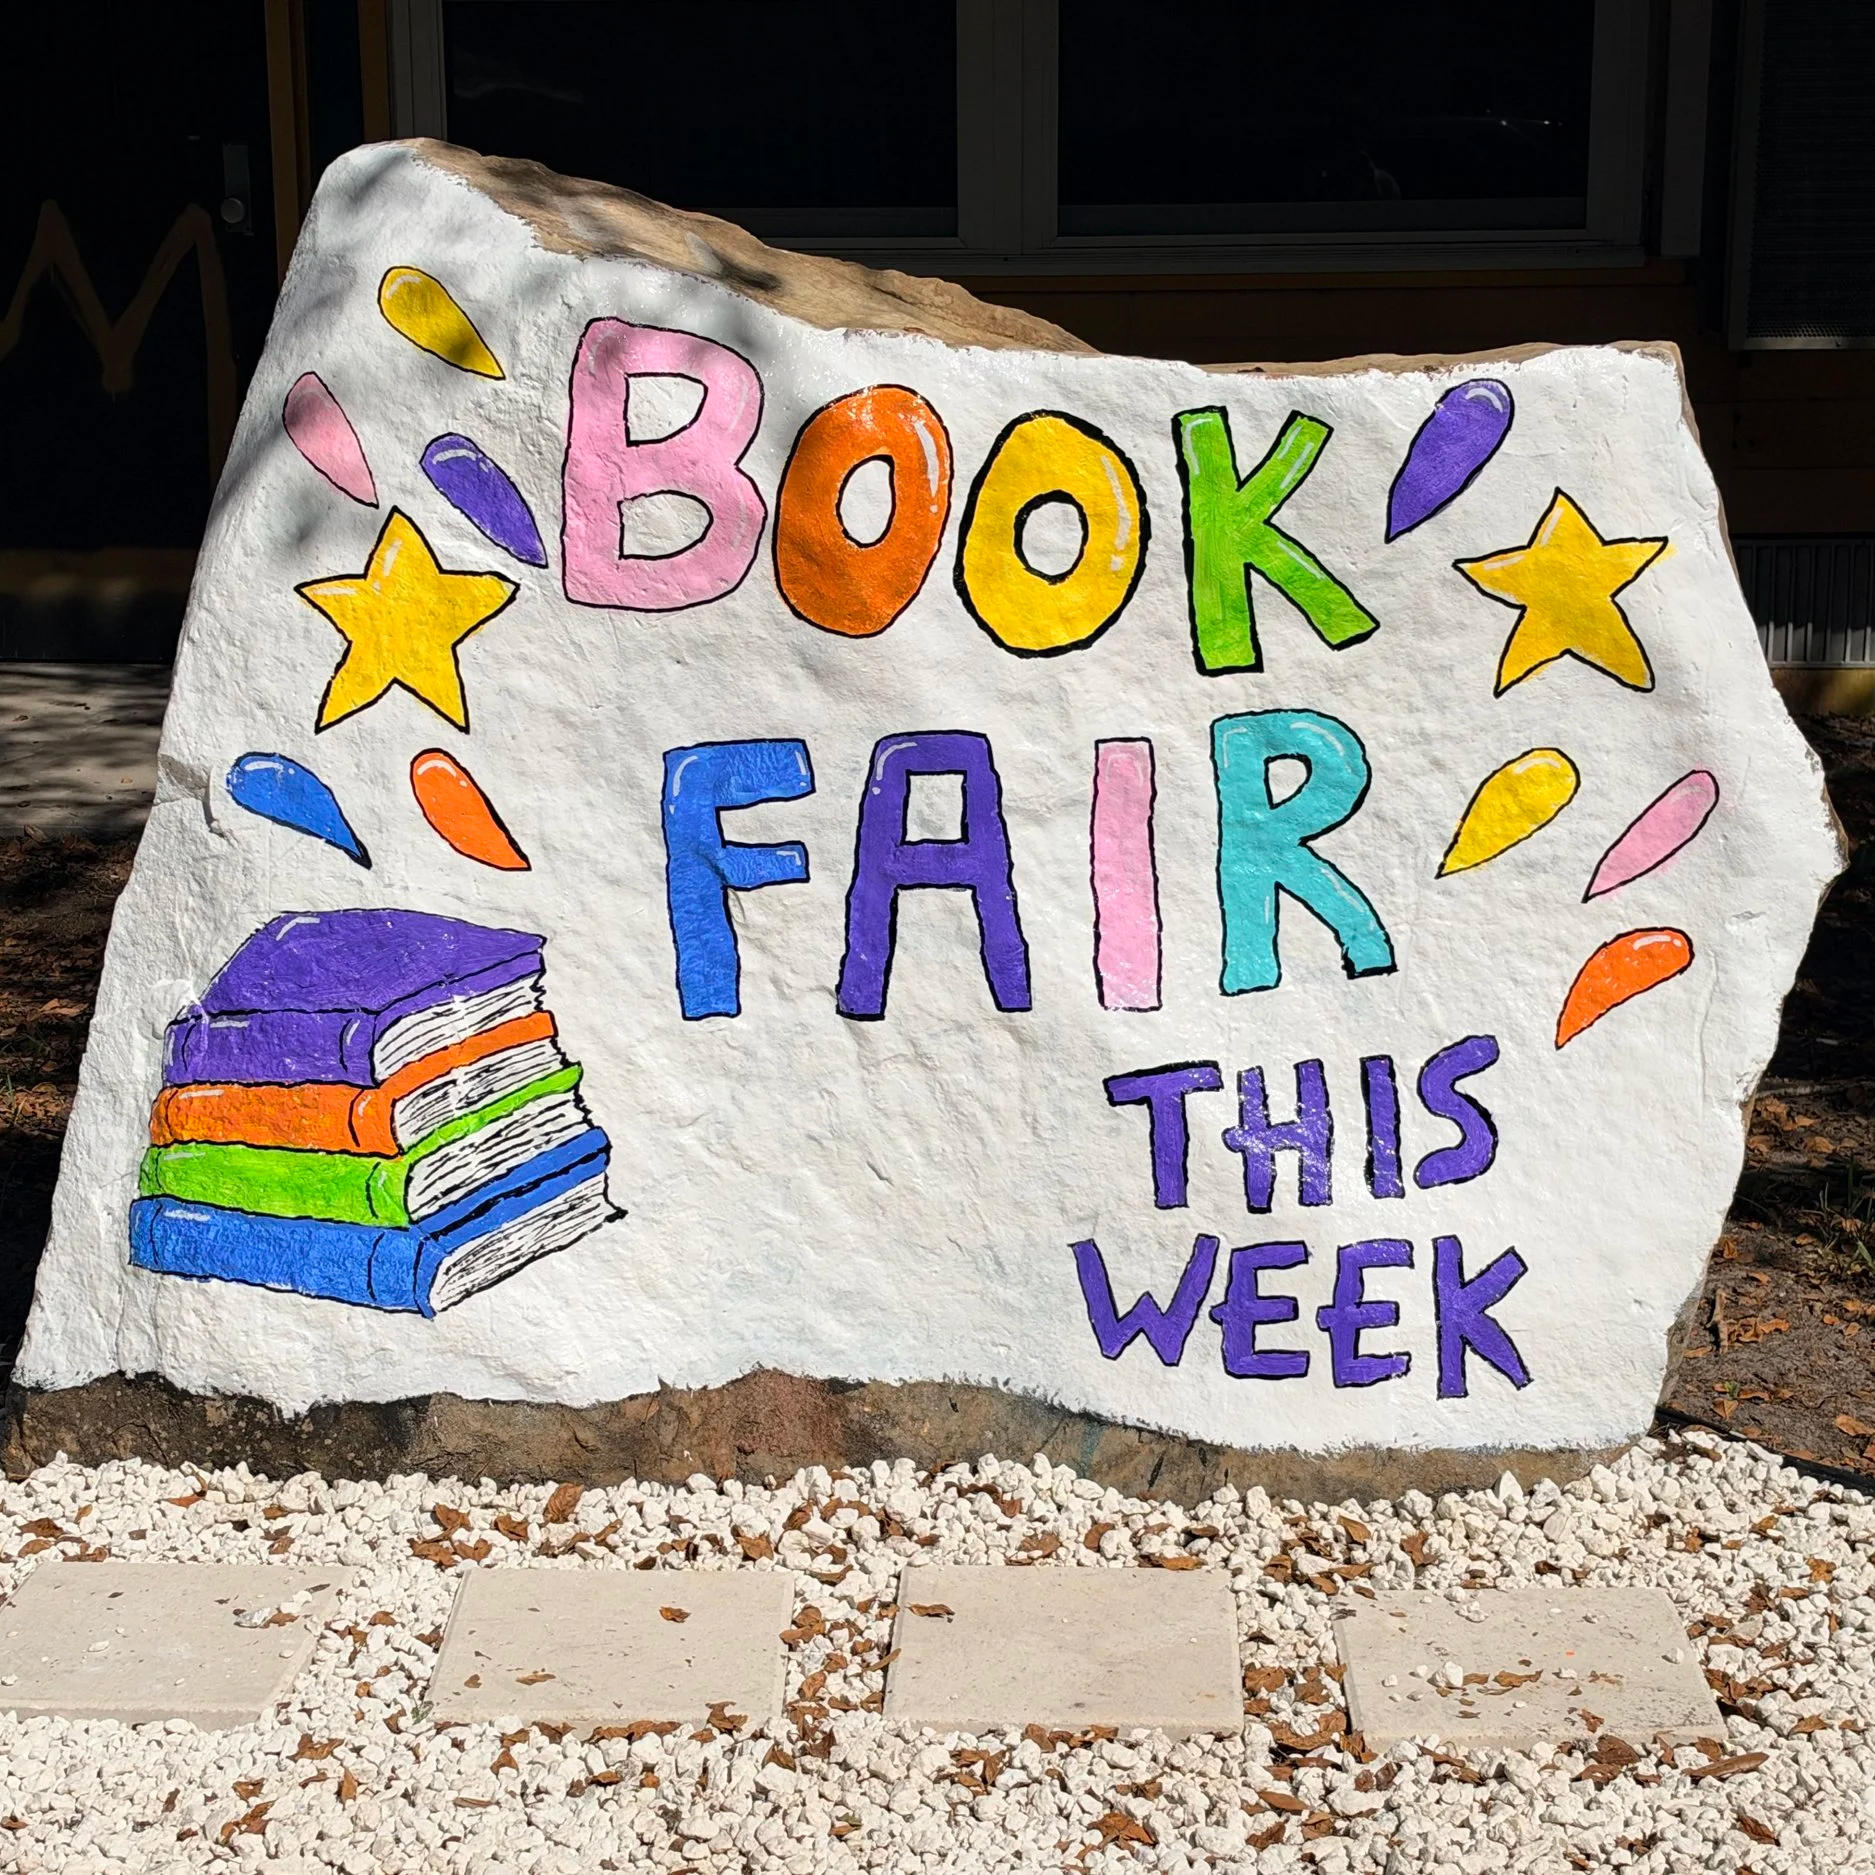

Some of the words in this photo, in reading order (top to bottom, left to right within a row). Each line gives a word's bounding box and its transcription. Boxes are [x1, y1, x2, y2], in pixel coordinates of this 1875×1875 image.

[561, 317, 1380, 675] BOOK
[661, 709, 1397, 1020] FAIR
[1103, 1034, 1500, 1213] THIS
[1068, 1233, 1532, 1399] WEEK
